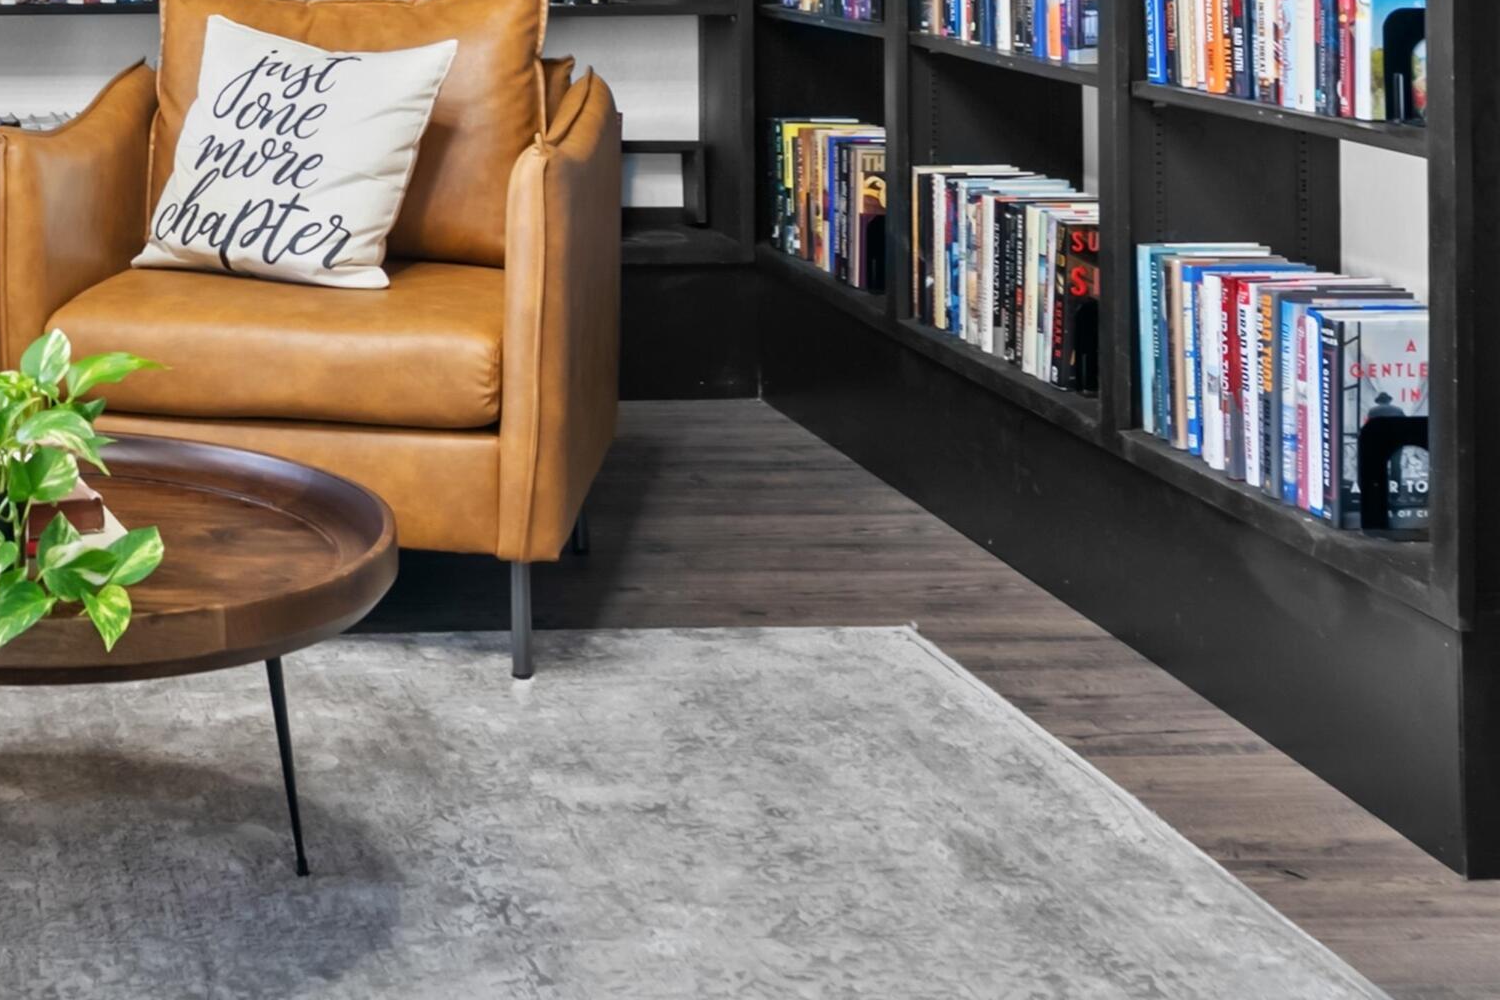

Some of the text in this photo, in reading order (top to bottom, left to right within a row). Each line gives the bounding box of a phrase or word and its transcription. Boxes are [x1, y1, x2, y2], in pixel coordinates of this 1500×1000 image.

[1257, 1, 1266, 37] INSIDER
[1147, 32, 1156, 59] WIFE
[1234, 27, 1244, 72] BAD FAITH
[1258, 41, 1267, 73] THREAT
[213, 50, 361, 118] just
[235, 92, 327, 139] one
[194, 135, 324, 190] more
[155, 168, 353, 271] chapter
[1015, 241, 1023, 285] SLAUGHTER
[1220, 312, 1228, 356] BRAD
[1239, 308, 1253, 461] BRAD THOR ACT OF WAR
[1261, 294, 1273, 476] BRAD THOR FULL BLACK
[1321, 367, 1332, 426] GENTLEMAN
[1321, 427, 1332, 438] IN
[1321, 441, 1332, 487] MOSCOW
